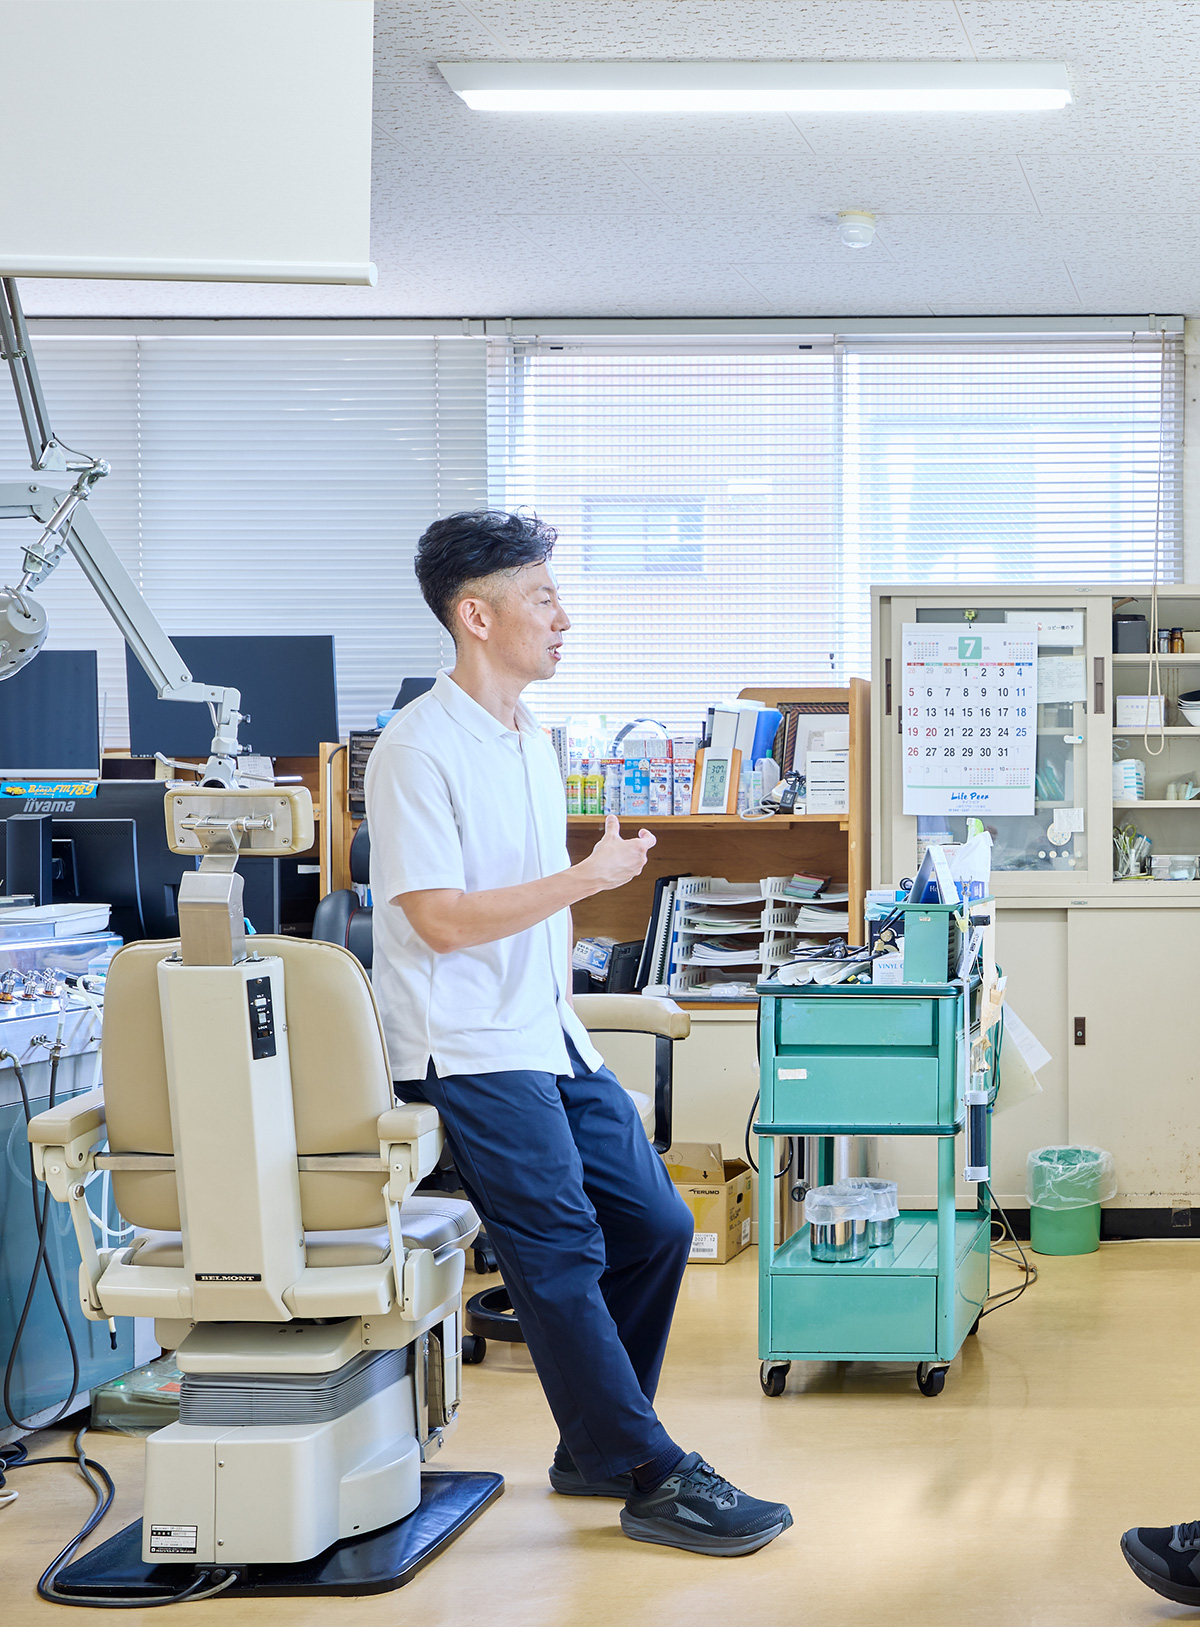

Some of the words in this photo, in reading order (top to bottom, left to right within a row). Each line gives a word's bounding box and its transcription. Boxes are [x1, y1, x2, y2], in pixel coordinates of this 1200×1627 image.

[964, 640, 976, 657] 7
[982, 668, 986, 676] 2
[999, 668, 1004, 677] 3
[1017, 668, 1022, 676] 4
[909, 688, 914, 696] 5
[927, 688, 932, 696] 6
[946, 688, 950, 696] 7
[963, 688, 968, 697] 8
[981, 688, 986, 697] 9
[998, 688, 1008, 696] 10
[1016, 688, 1025, 696] 11
[908, 708, 918, 716] 12
[926, 708, 936, 716] 13
[944, 708, 954, 716] 14
[962, 708, 972, 717] 15
[981, 708, 990, 717] 16
[998, 708, 1008, 716] 17
[1016, 708, 1026, 716] 18
[908, 727, 918, 736] 19
[926, 728, 937, 736] 20
[944, 728, 953, 736] 21
[962, 728, 973, 736] 22
[980, 728, 991, 736] 23
[998, 728, 1008, 736] 24
[1016, 728, 1026, 736] 25
[908, 747, 918, 756] 26
[926, 748, 936, 756] 27
[944, 748, 955, 756] 28
[962, 748, 973, 756] 29
[980, 748, 991, 756] 30
[998, 748, 1007, 756] 31
[951, 792, 968, 800] Life
[23, 798, 76, 812] iiyama
